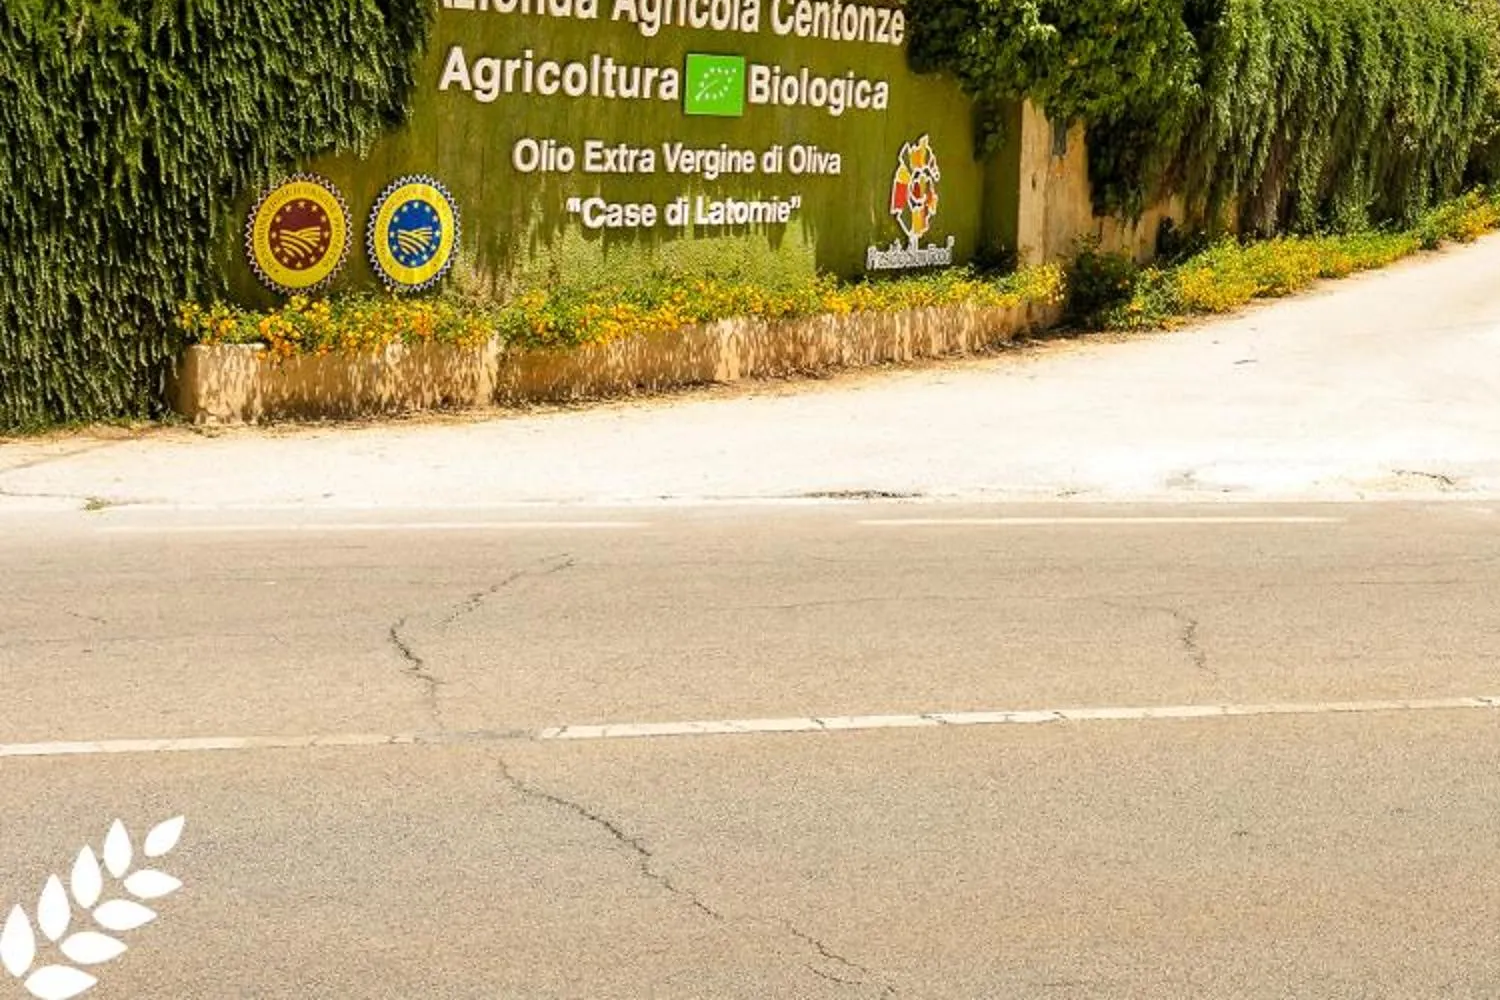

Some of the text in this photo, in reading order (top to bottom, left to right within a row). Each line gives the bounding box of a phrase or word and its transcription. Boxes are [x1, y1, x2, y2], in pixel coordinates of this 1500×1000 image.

[439, 46, 889, 116] Agricoltura Biologica
[512, 138, 841, 180] Olio Extra Vergine di Oliva
[665, 196, 689, 226] di
